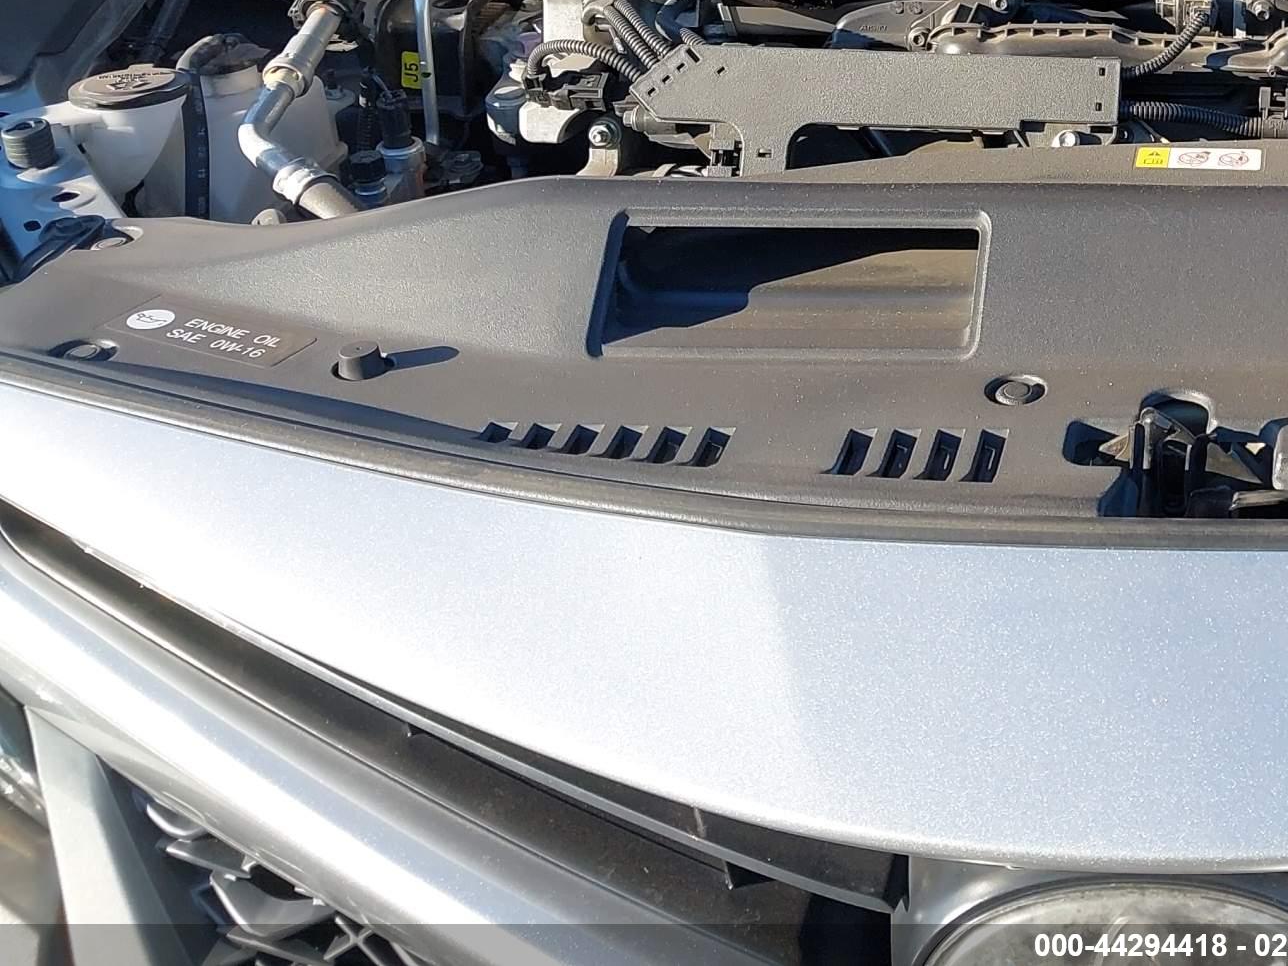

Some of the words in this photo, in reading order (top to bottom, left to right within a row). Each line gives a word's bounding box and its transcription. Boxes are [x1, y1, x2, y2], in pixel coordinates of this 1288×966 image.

[404, 62, 419, 83] J5
[166, 328, 207, 344] SAE
[209, 339, 266, 359] 0W-16
[184, 318, 250, 340] ENGINE
[253, 333, 282, 348] OIL
